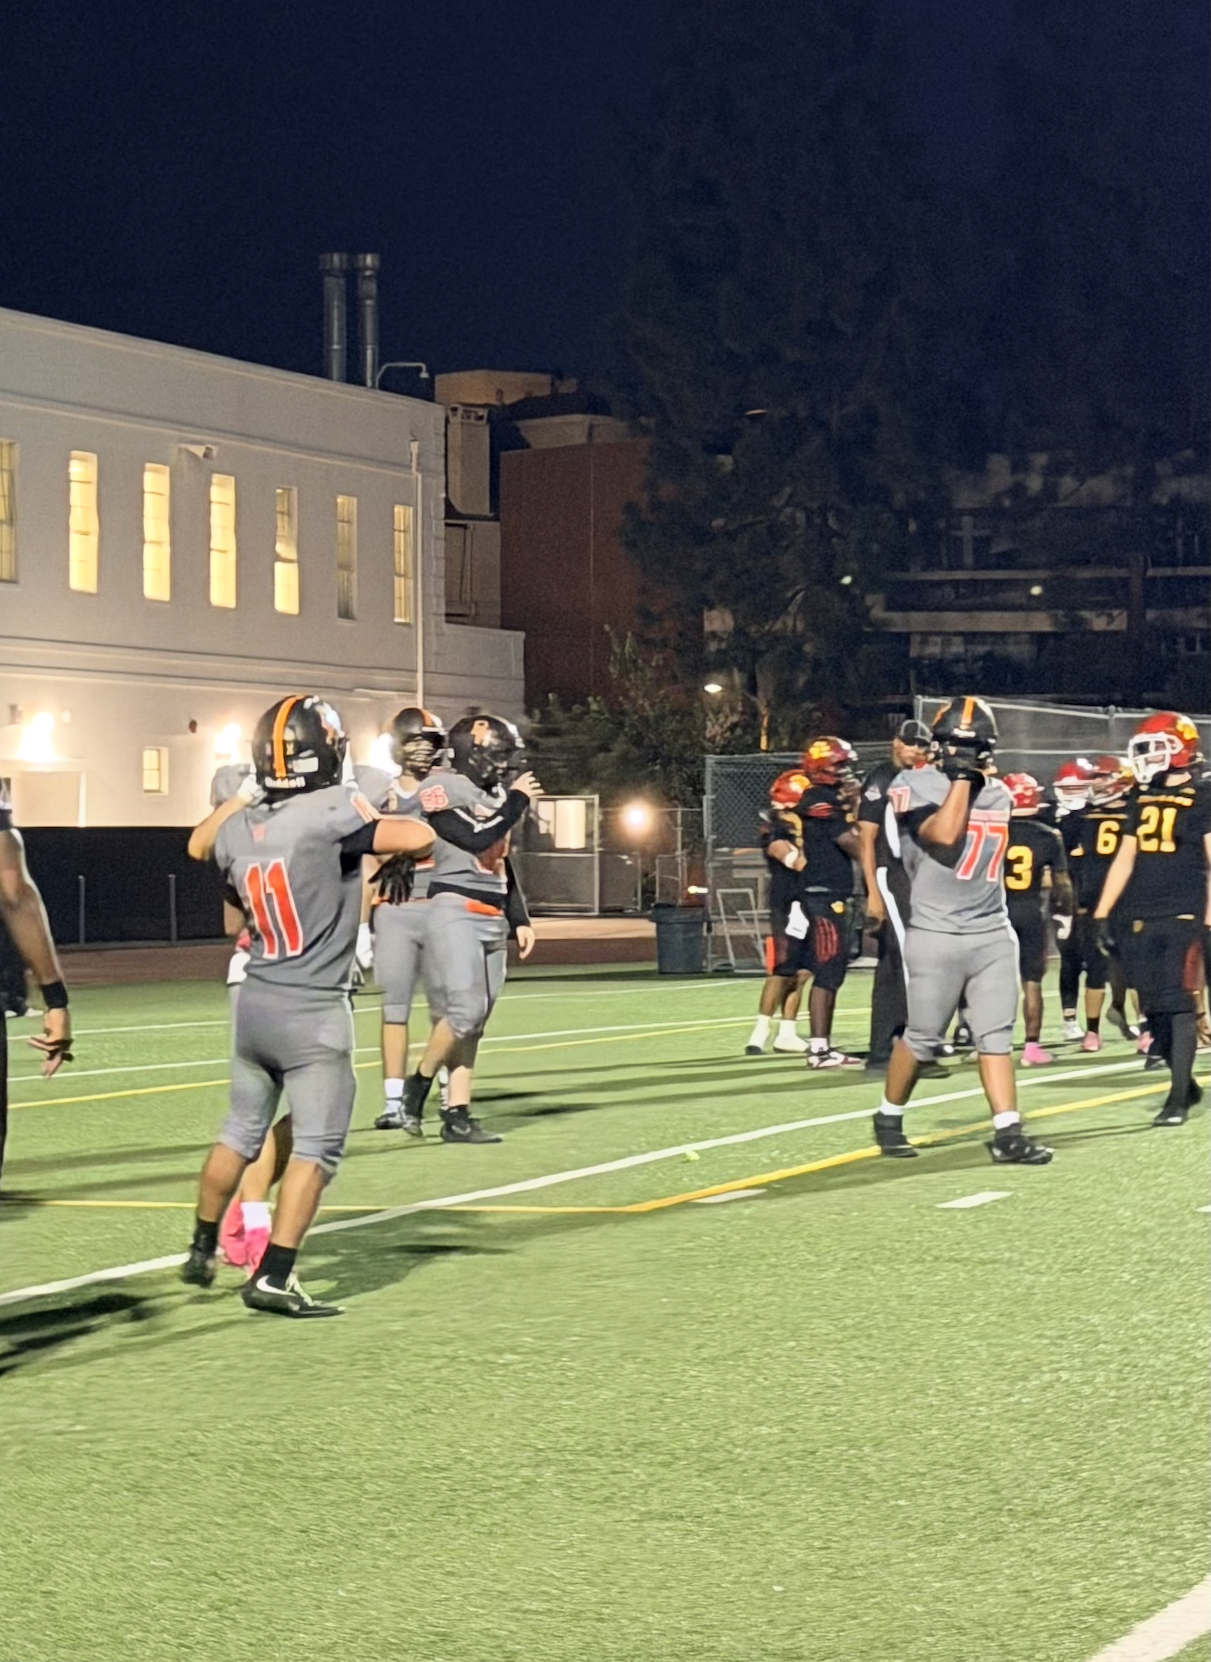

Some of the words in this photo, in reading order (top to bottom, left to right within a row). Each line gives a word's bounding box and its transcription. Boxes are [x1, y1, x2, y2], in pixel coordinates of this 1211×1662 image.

[956, 820, 1009, 882] 77
[1096, 820, 1120, 855] 6
[1136, 805, 1177, 853] 21
[245, 857, 303, 958] 11
